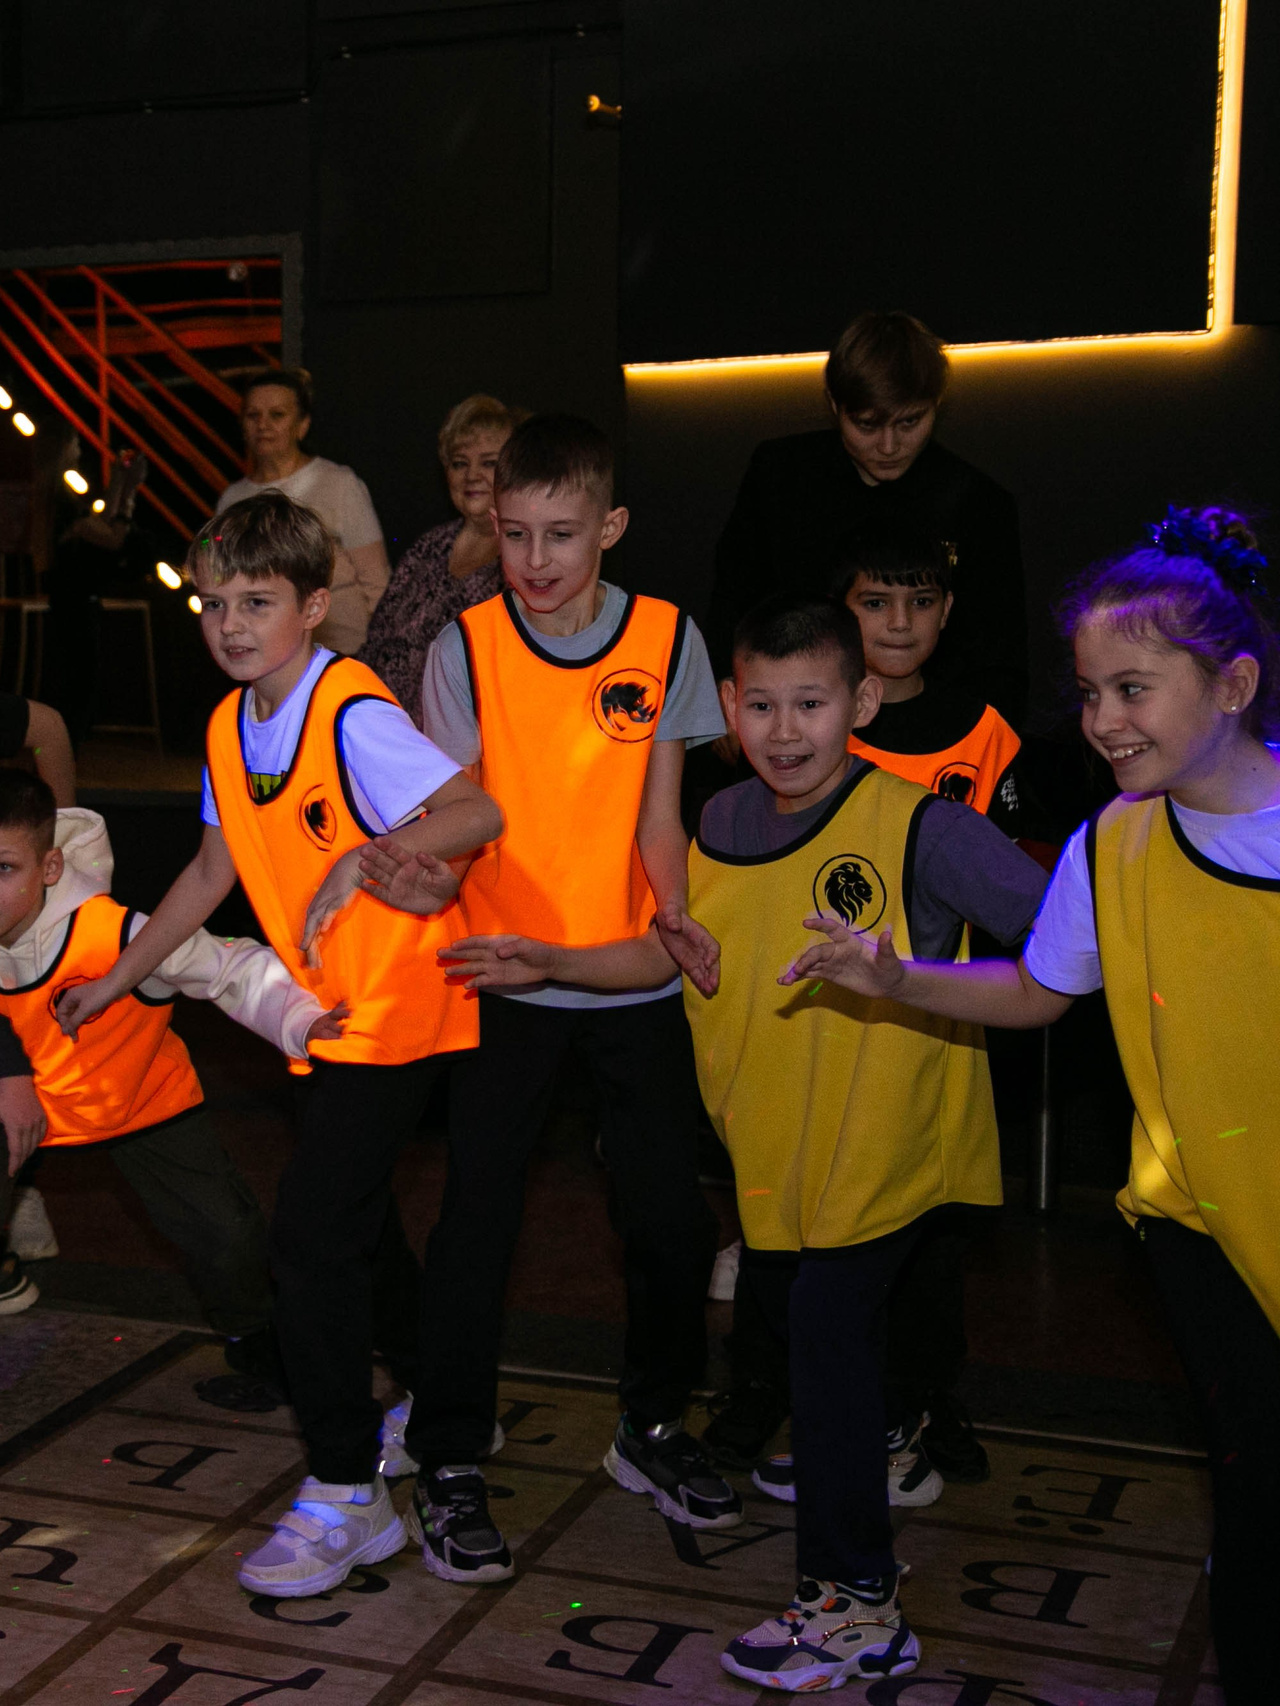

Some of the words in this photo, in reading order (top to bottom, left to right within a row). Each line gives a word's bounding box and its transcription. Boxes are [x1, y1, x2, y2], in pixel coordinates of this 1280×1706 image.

[1013, 1464, 1151, 1536] Ё
[960, 1560, 1111, 1629] В
[545, 1615, 714, 1688] Б
